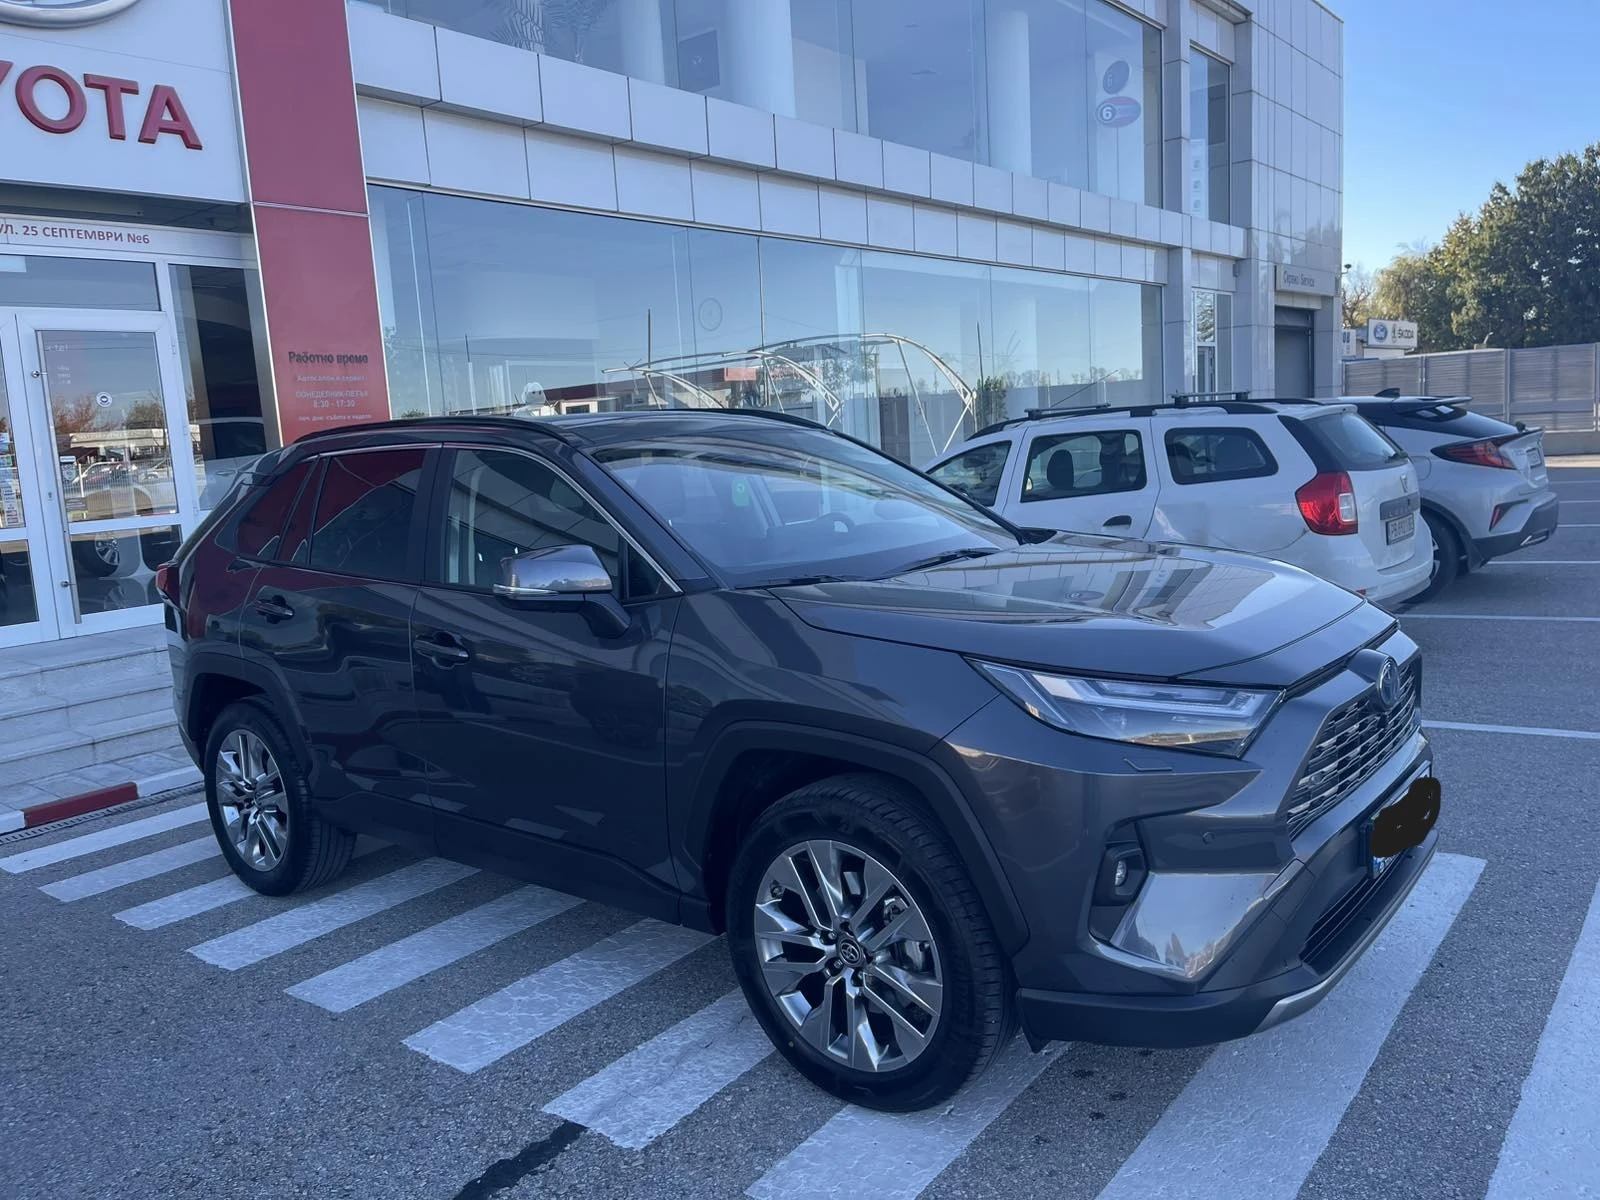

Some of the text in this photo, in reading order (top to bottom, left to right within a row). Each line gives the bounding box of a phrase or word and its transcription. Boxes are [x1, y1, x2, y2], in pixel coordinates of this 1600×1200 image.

[22, 225, 39, 236] 25
[42, 227, 124, 242] СЕПТЕМВРИ
[127, 233, 150, 244] №6
